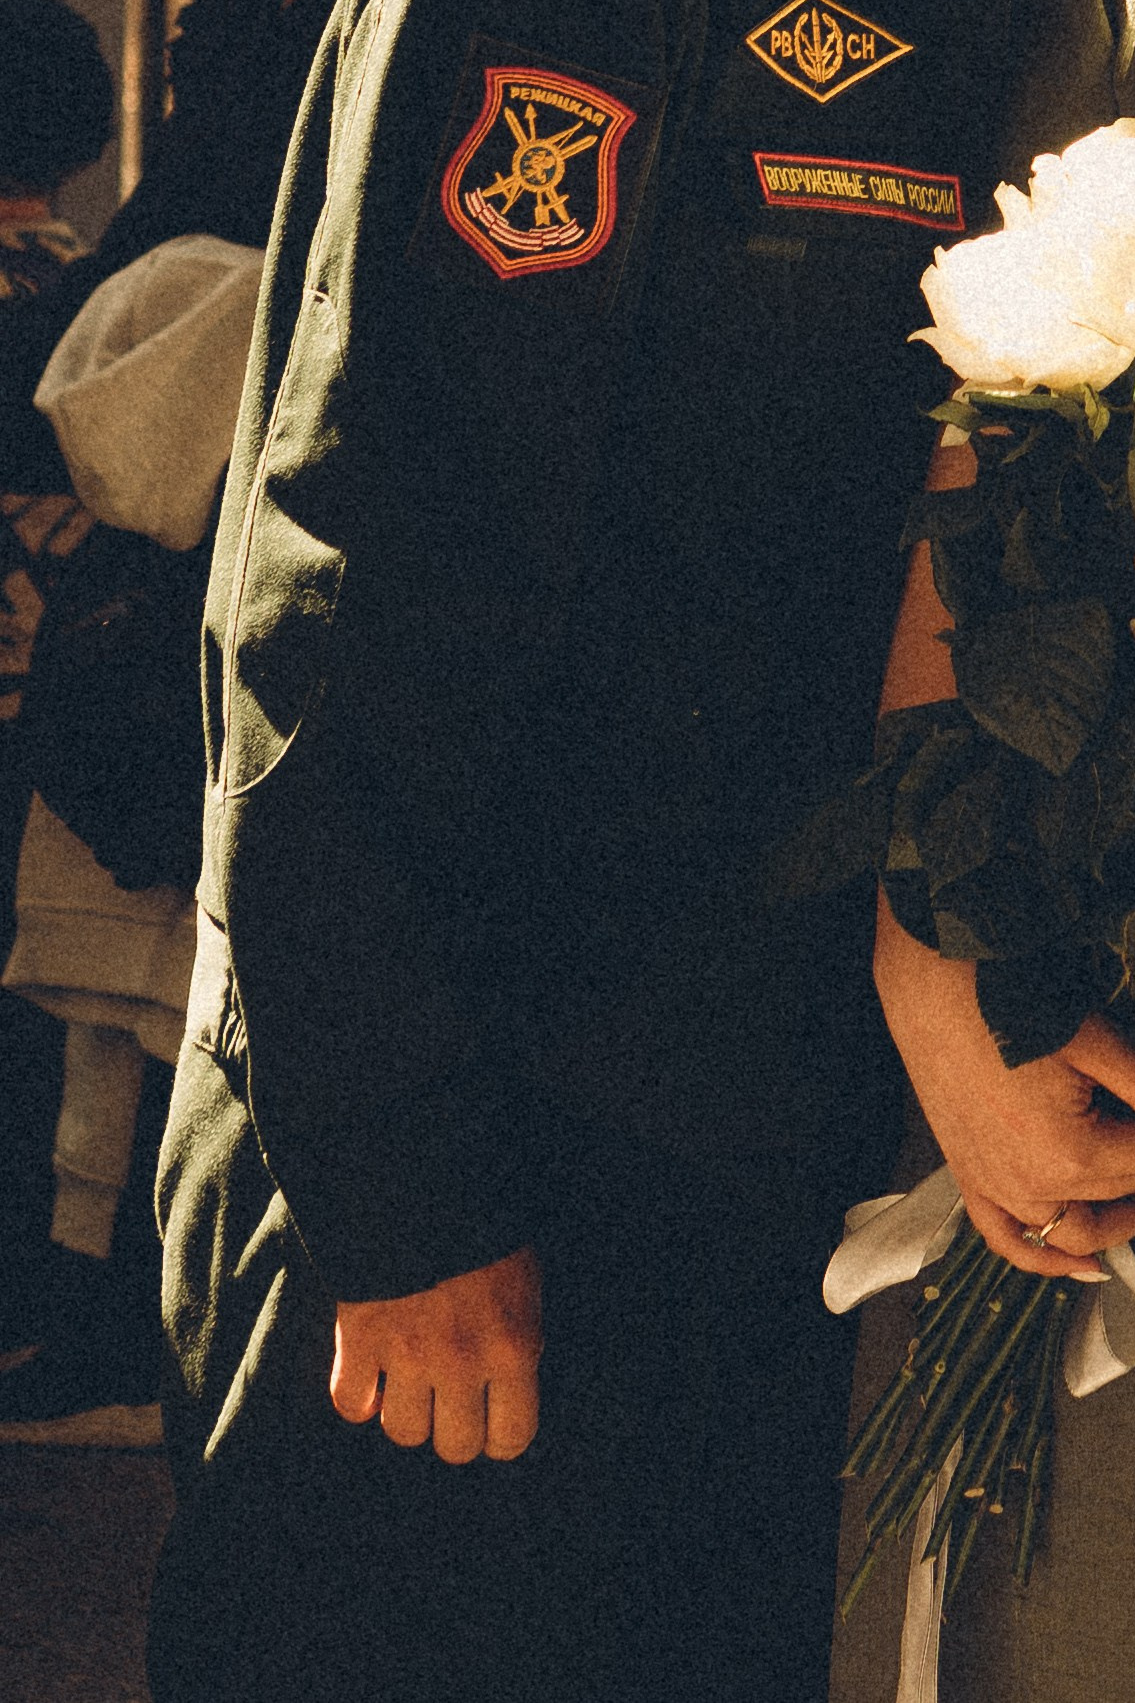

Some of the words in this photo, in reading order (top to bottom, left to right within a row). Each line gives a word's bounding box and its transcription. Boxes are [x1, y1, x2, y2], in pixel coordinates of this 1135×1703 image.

[510, 86, 606, 127] РЕЖИЦКАЯ
[764, 164, 868, 200] ВООРУЖЕННЫЕ
[869, 175, 906, 205] СИЛЫ
[907, 182, 956, 215] РОССИИ
